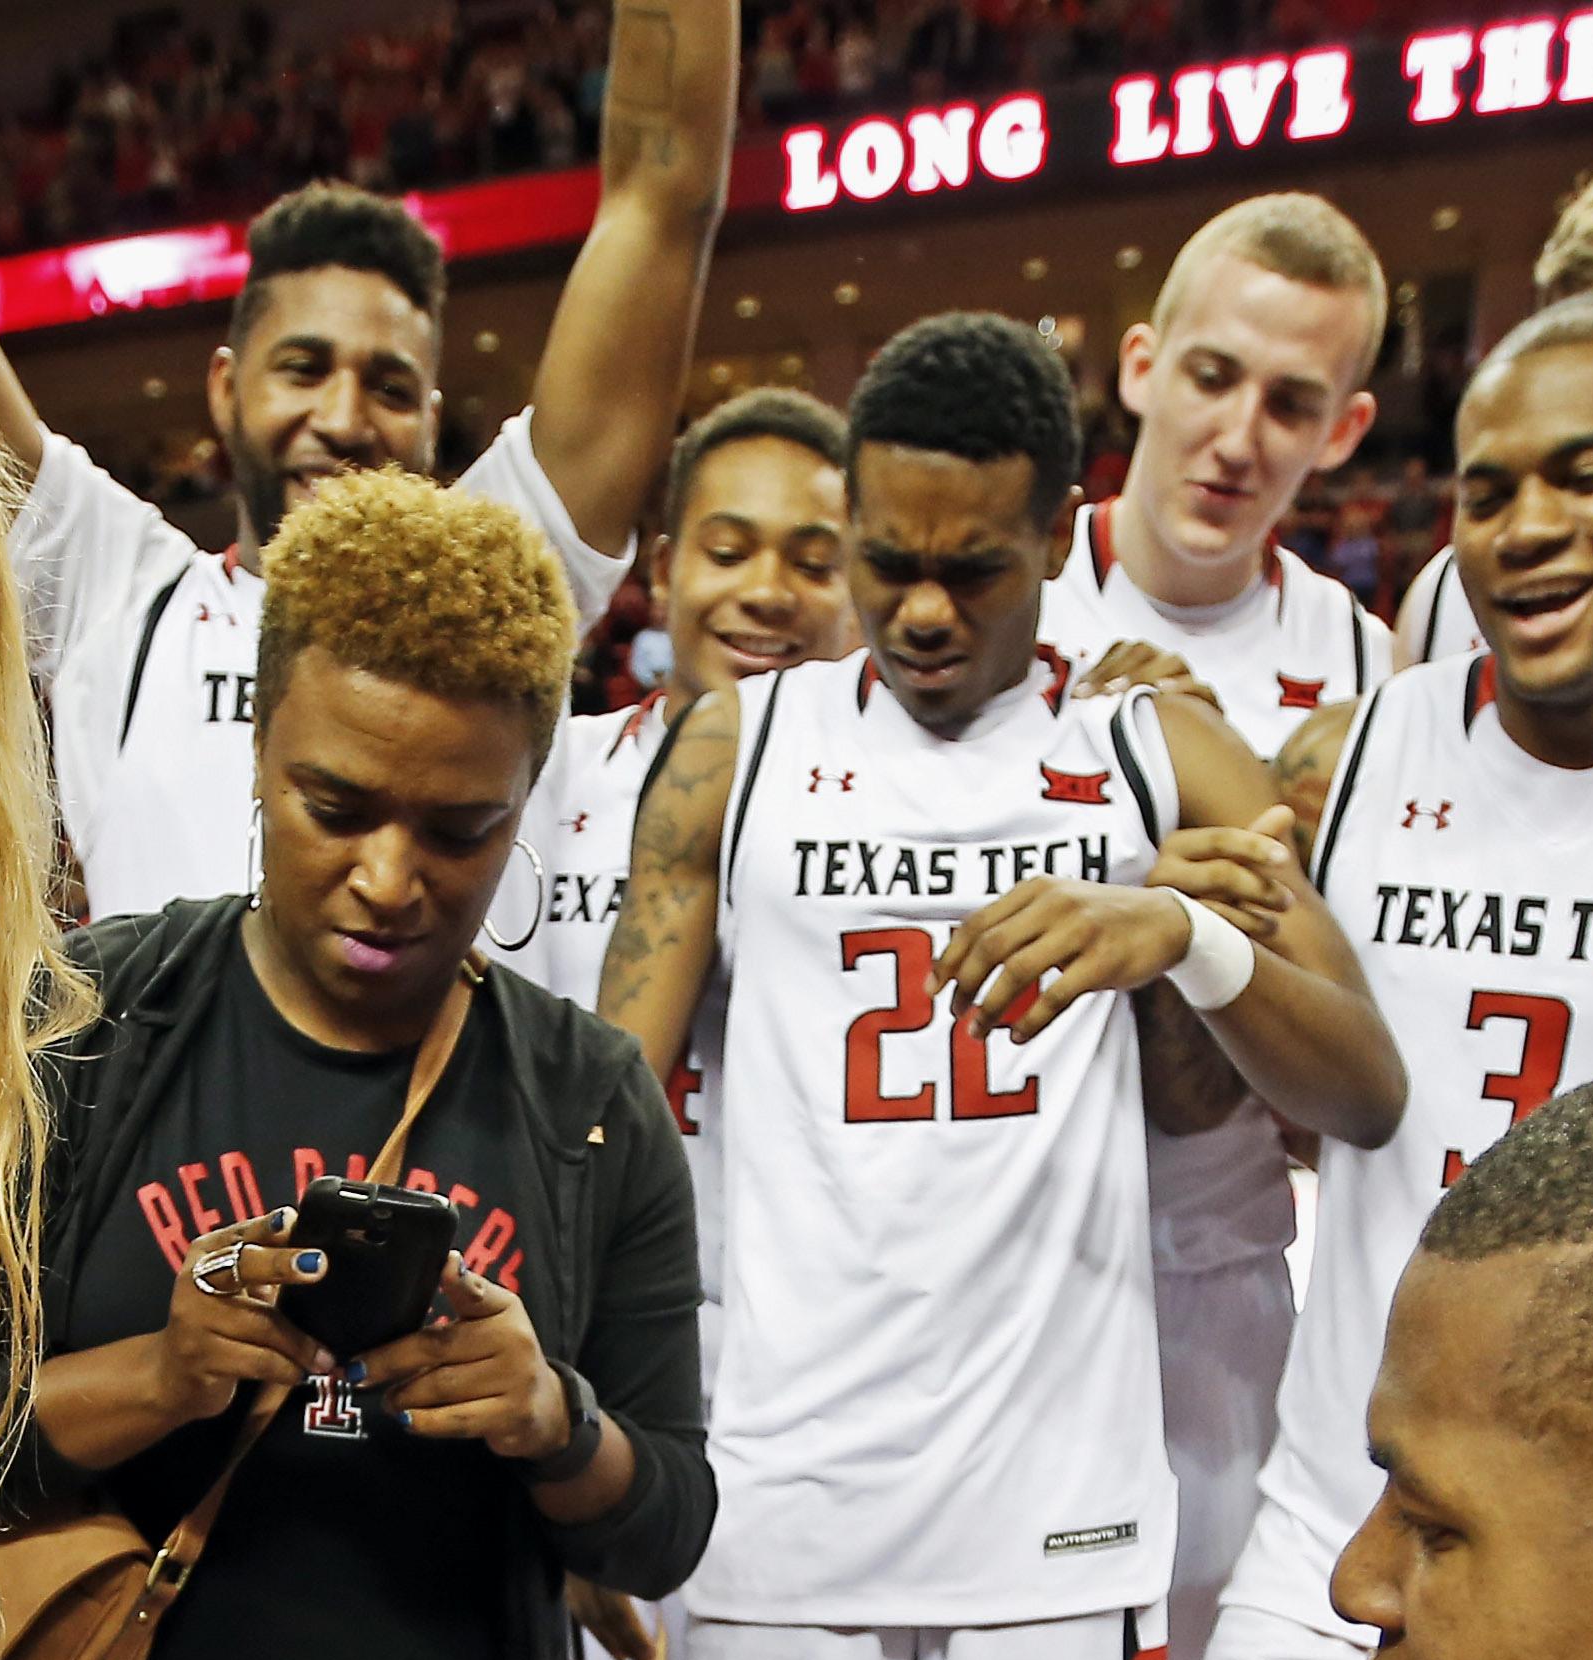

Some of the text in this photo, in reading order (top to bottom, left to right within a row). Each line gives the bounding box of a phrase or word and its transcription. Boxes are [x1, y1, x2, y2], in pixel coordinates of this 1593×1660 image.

[784, 91, 1047, 211] LONG
[1109, 47, 1351, 167] LIVE
[793, 835, 1109, 897] TEXAS TECH
[1372, 884, 1548, 956] TEXAS
